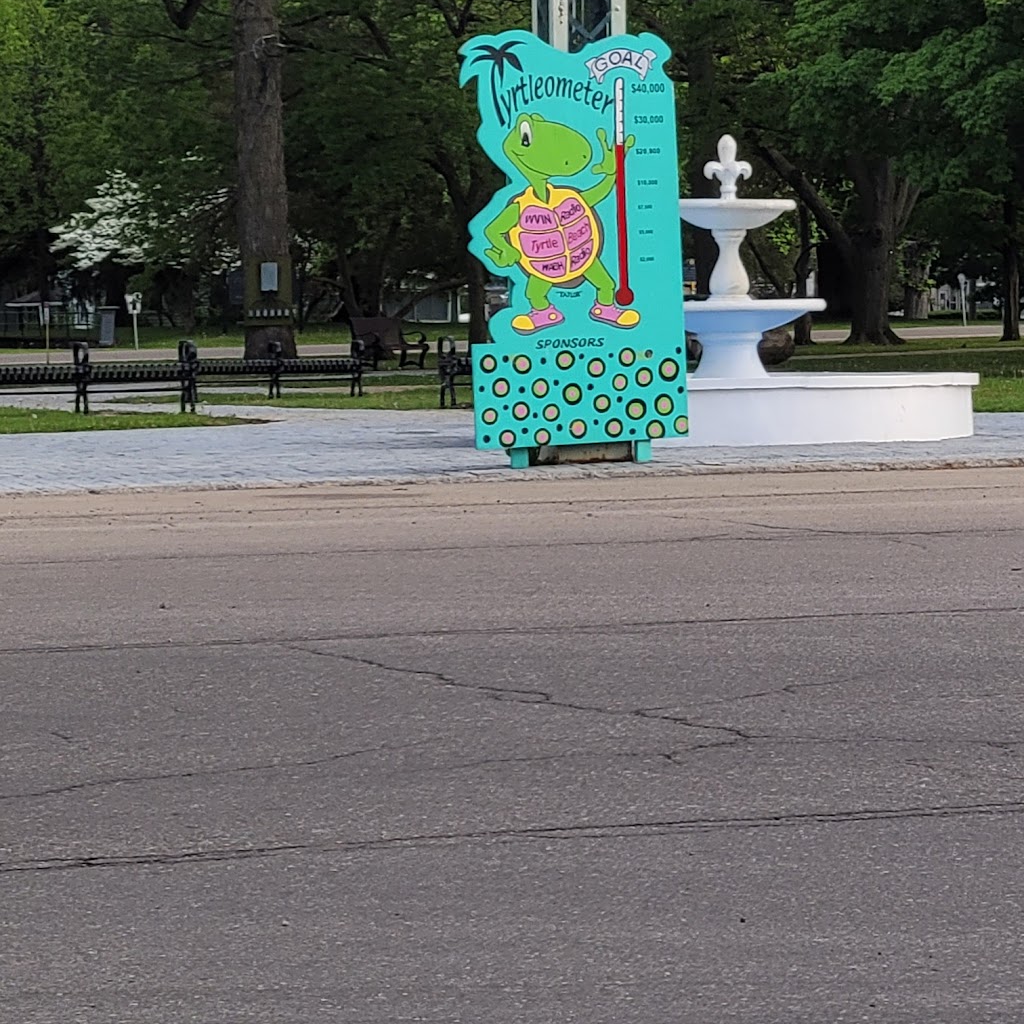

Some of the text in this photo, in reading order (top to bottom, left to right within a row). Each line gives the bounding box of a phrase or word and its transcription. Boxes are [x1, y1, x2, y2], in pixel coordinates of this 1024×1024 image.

[595, 50, 645, 72] GOAL
[631, 82, 665, 94] $40,000
[634, 114, 664, 125] $30,000
[525, 214, 553, 225] WVIN
[560, 202, 582, 223] Radio
[567, 223, 590, 244] Beach
[531, 238, 559, 254] Tyrtle
[571, 247, 591, 267] Radio
[535, 337, 605, 350] SPONSORS
